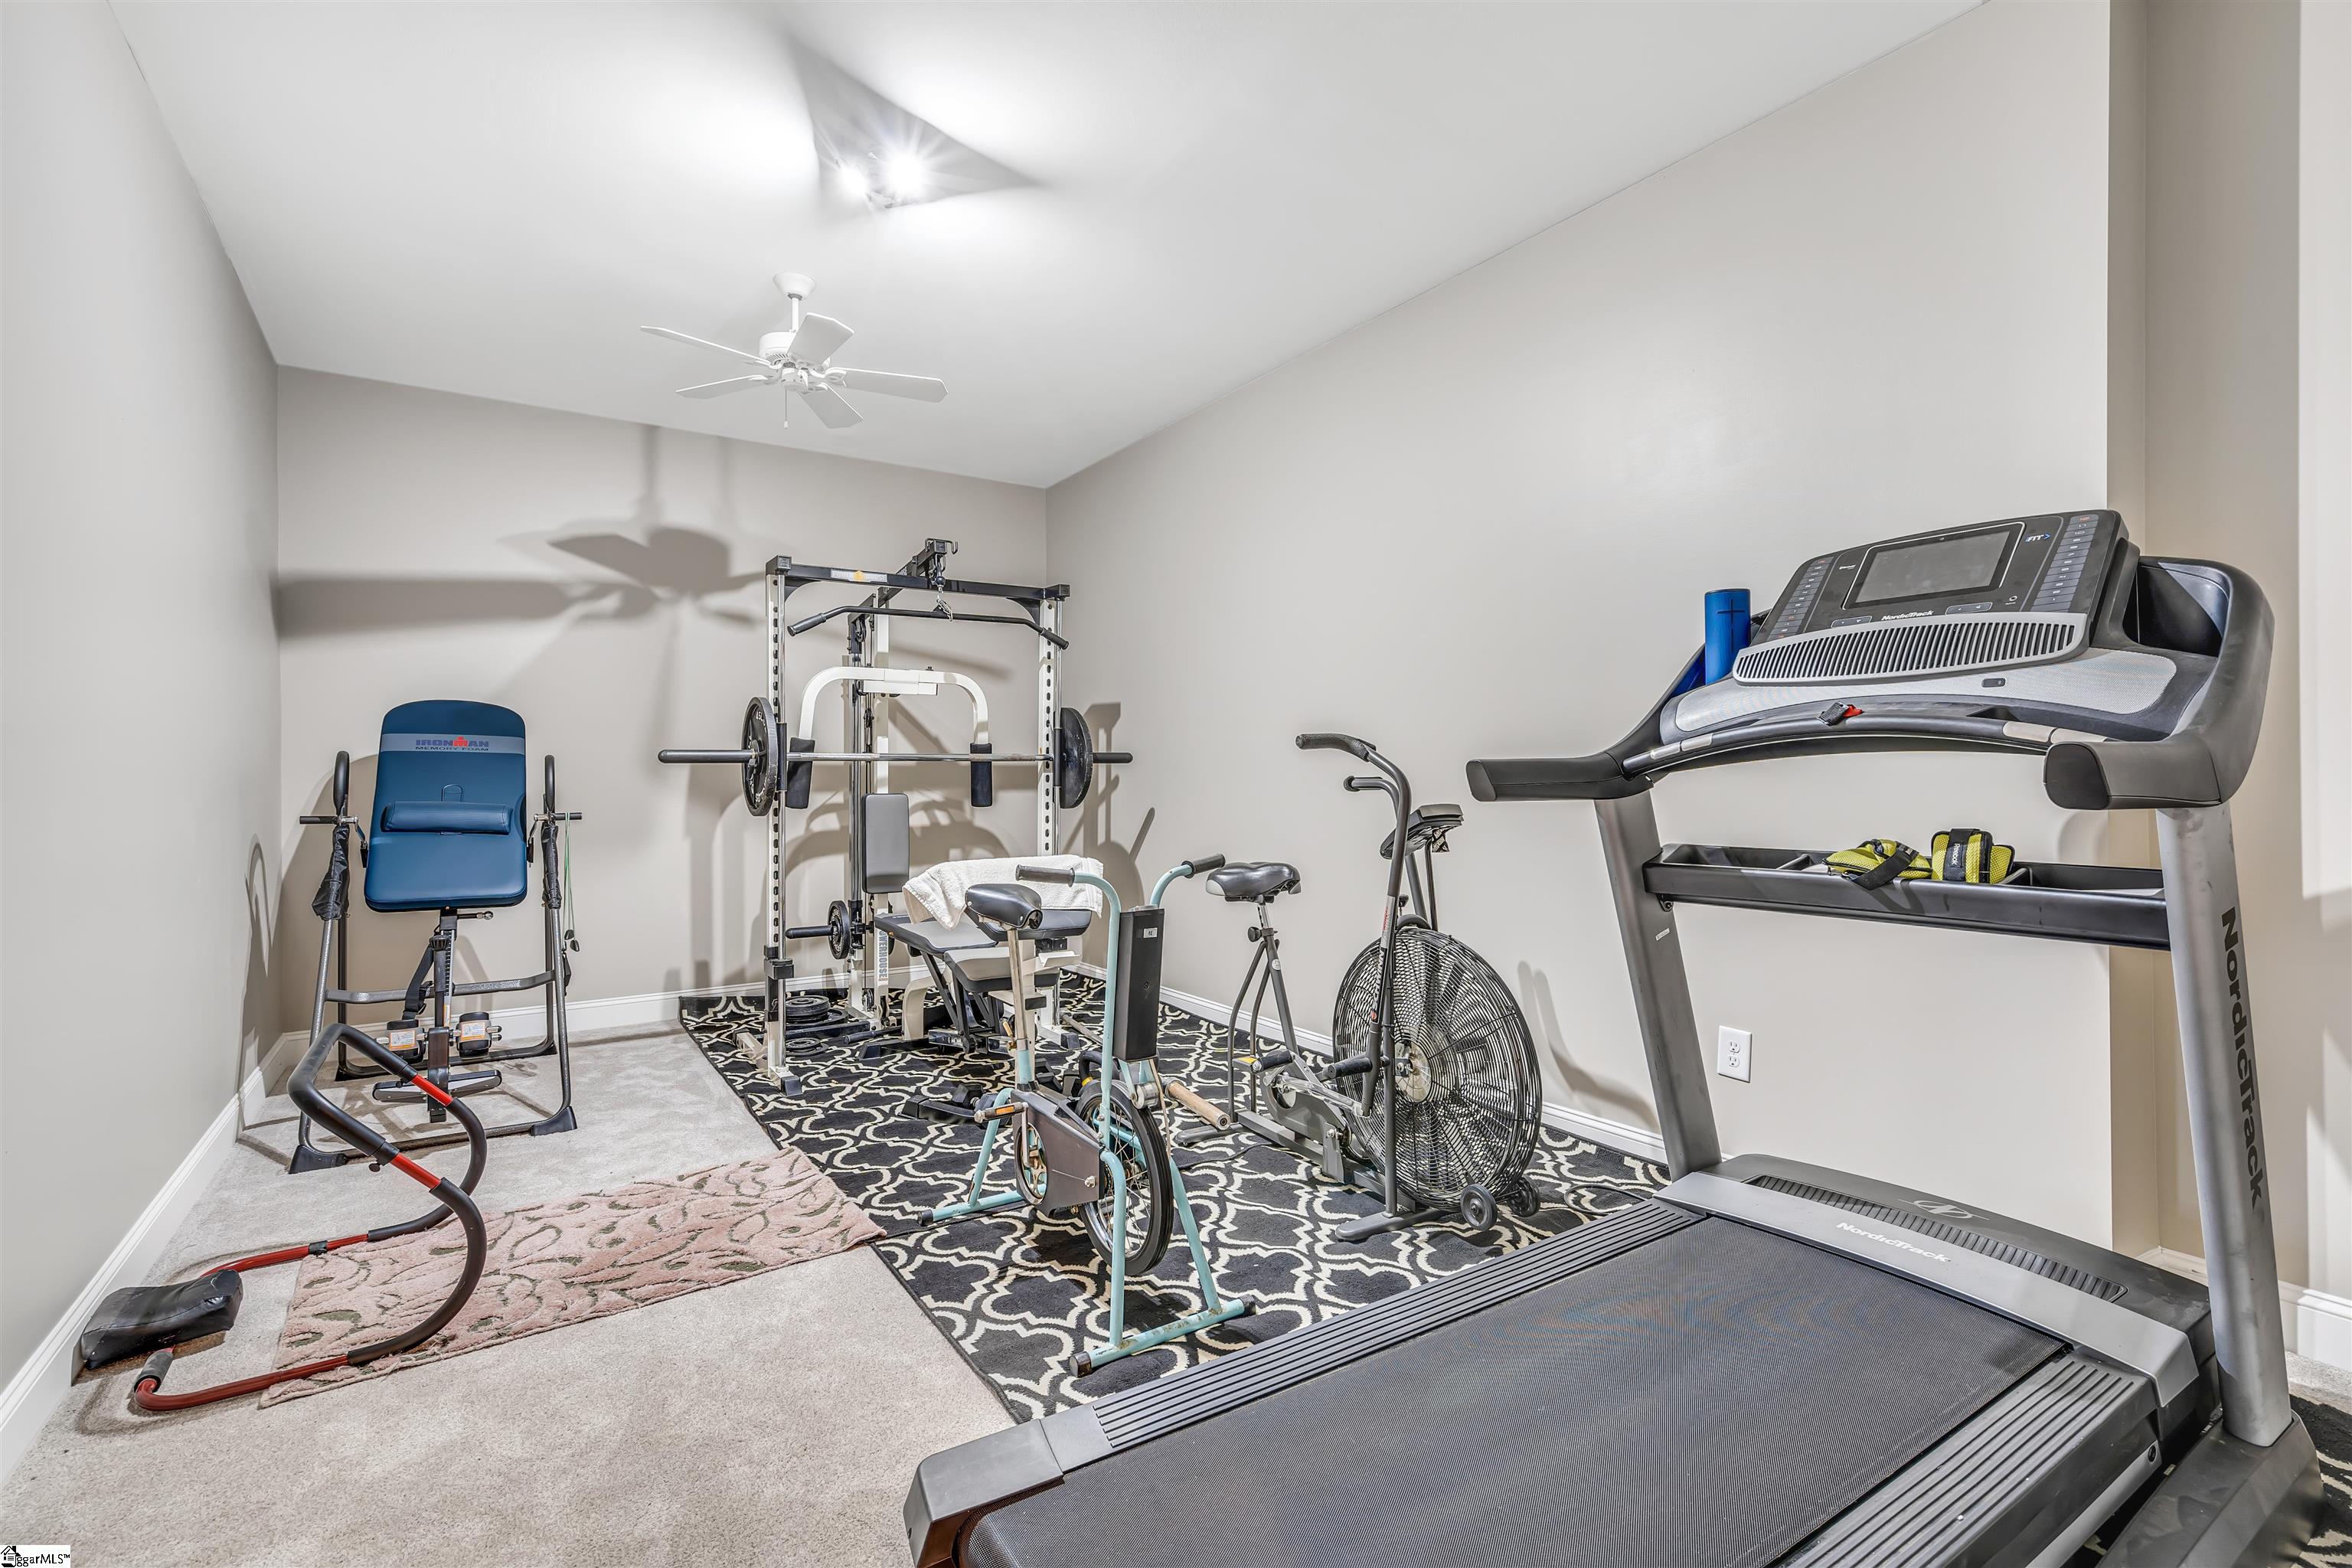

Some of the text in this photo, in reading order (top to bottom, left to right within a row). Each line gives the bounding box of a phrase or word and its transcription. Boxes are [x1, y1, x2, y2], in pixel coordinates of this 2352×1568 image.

[865, 573, 887, 583] HOUSE
[1880, 610, 1934, 621] NordicTrack
[416, 736, 489, 747] IRONMAN
[1952, 843, 1961, 866] Reebok
[879, 930, 888, 978] OWERHOUSE
[1372, 949, 1385, 1011] SCHWINN
[2221, 906, 2263, 1210] NordicTrack
[1835, 1220, 1952, 1263] NordicTrack
